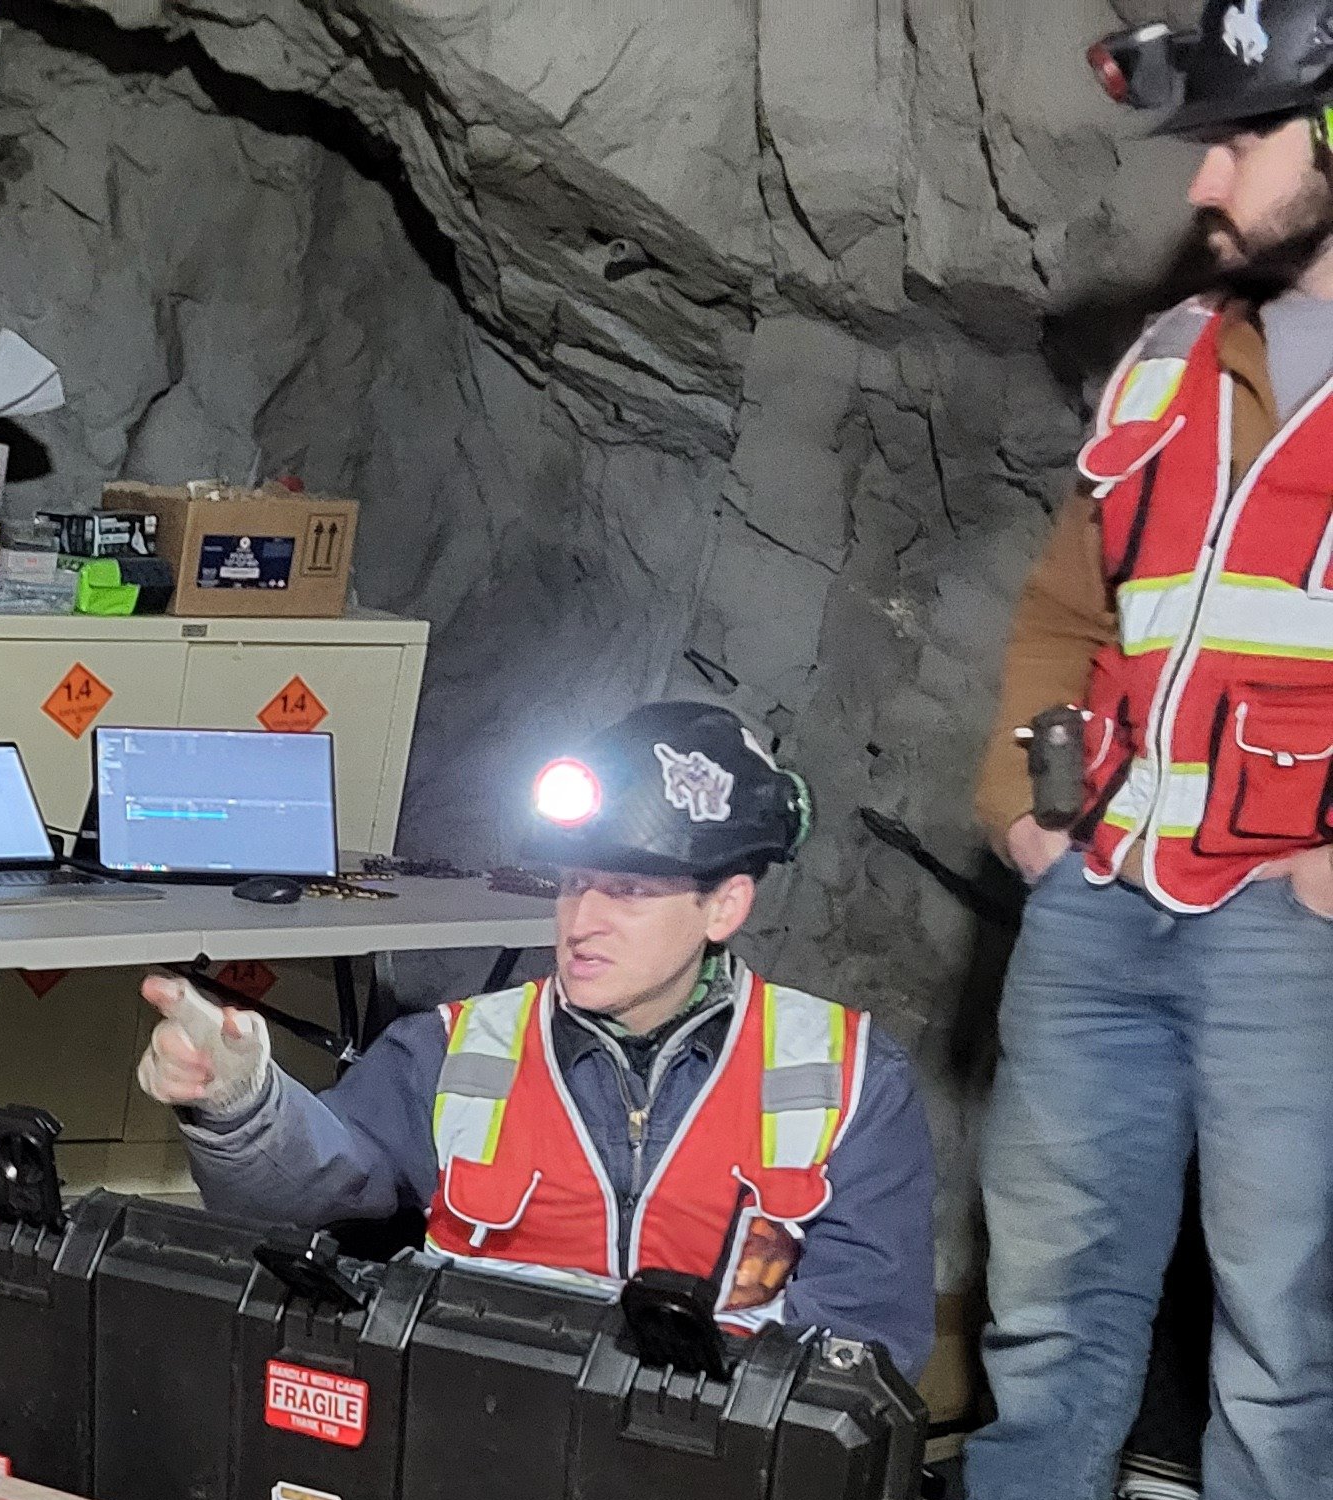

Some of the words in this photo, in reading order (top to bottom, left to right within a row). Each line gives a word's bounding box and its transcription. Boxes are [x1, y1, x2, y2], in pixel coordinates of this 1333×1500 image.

[62, 679, 92, 702] 1.4
[281, 693, 307, 713] 1.4
[269, 1364, 309, 1383] HANDLE
[335, 1380, 365, 1398] CARE
[273, 1382, 359, 1424] FRAGILE
[290, 1414, 320, 1432] THANK
